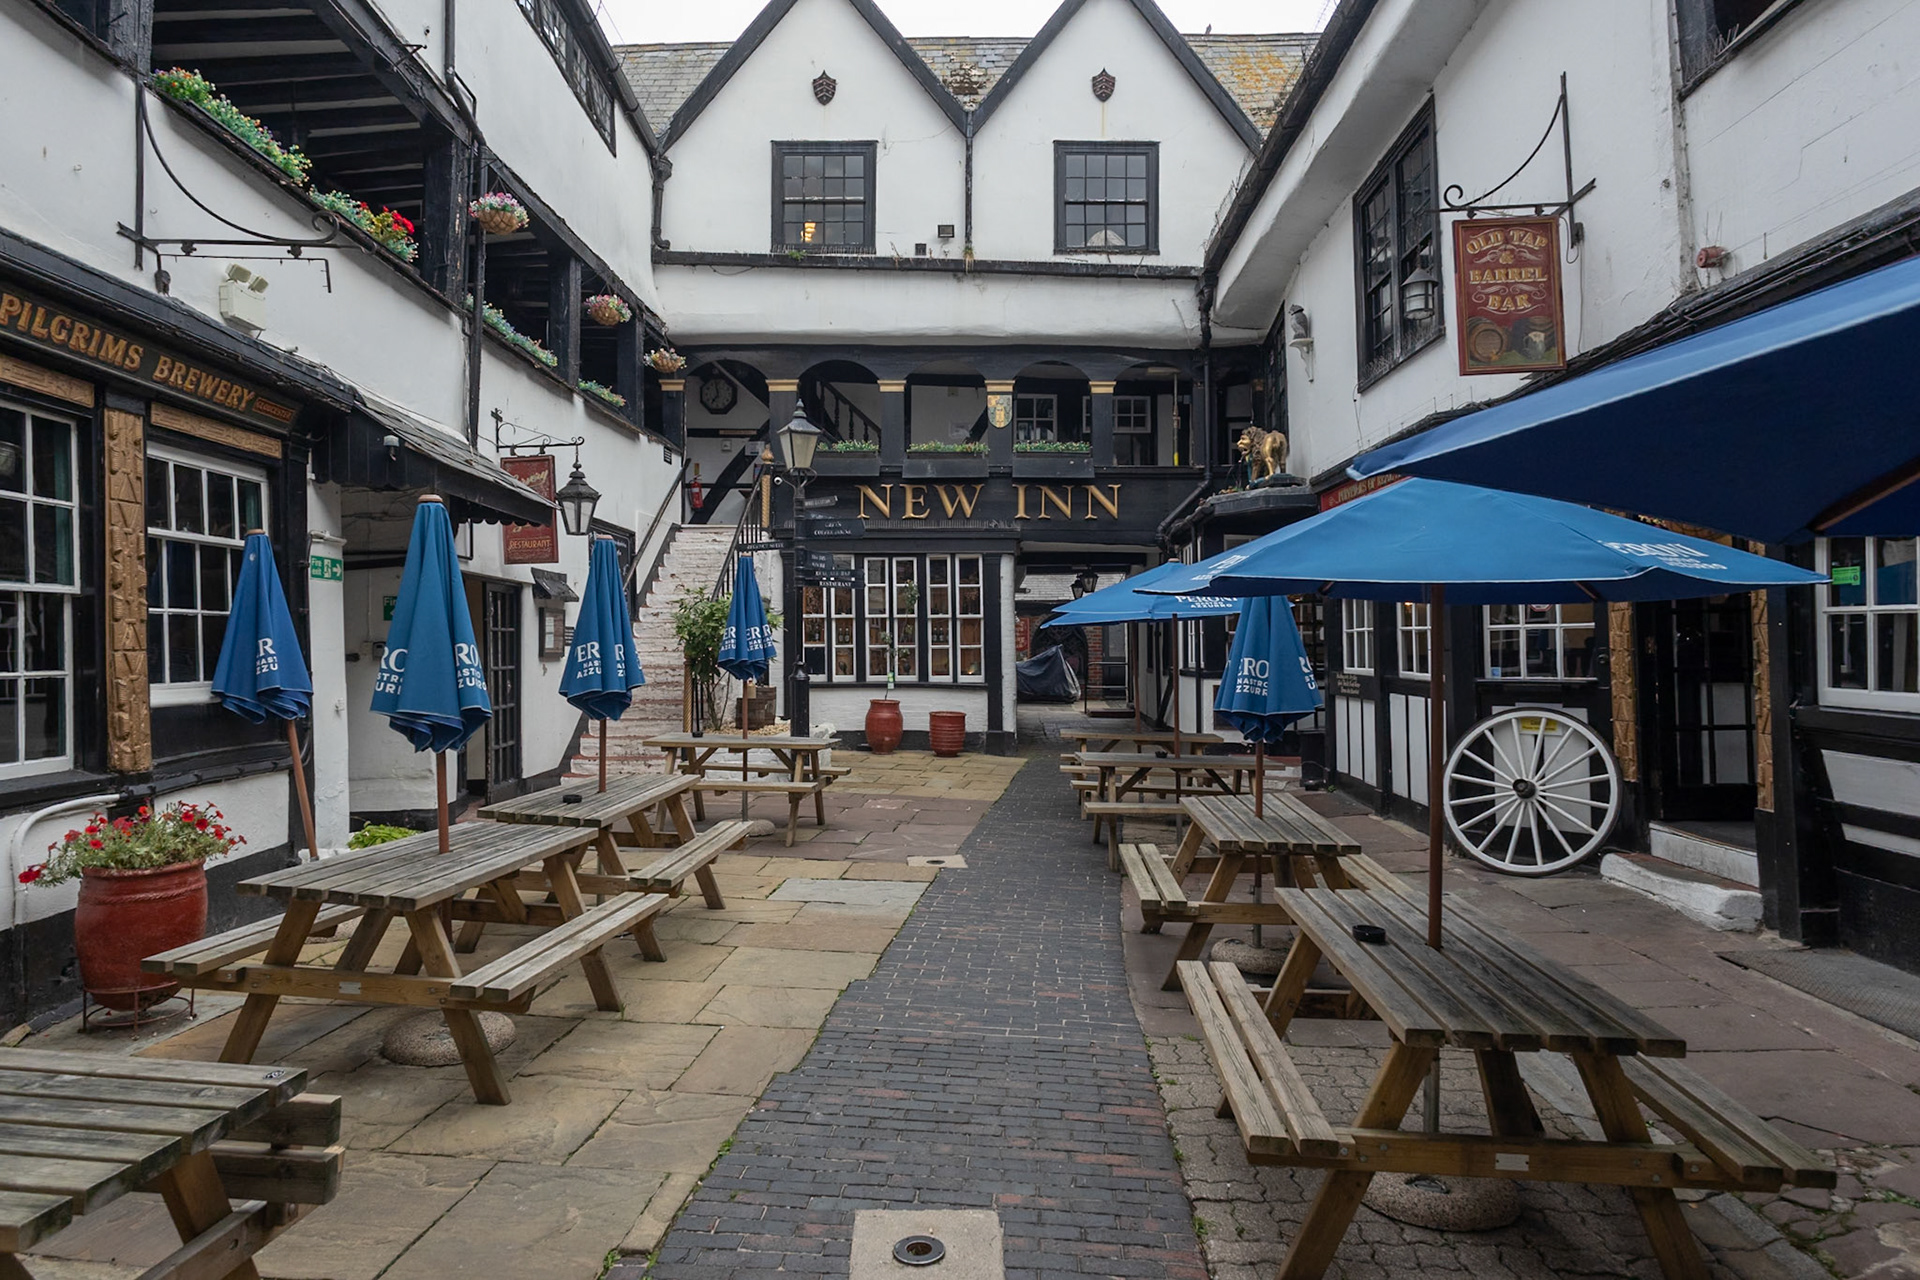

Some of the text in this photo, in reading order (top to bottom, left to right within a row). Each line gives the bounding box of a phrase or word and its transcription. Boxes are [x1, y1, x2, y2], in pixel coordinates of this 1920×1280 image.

[1466, 229, 1548, 254] OLD TAP
[1499, 251, 1514, 265] &
[1469, 266, 1548, 284] BARREL
[1487, 293, 1531, 311] BAR
[0, 293, 256, 411] PILGRIMS BREWERY
[854, 483, 1122, 519] NEW INN
[509, 539, 551, 549] RESTAURANT
[311, 557, 322, 567] Fire
[583, 660, 601, 669] NAS
